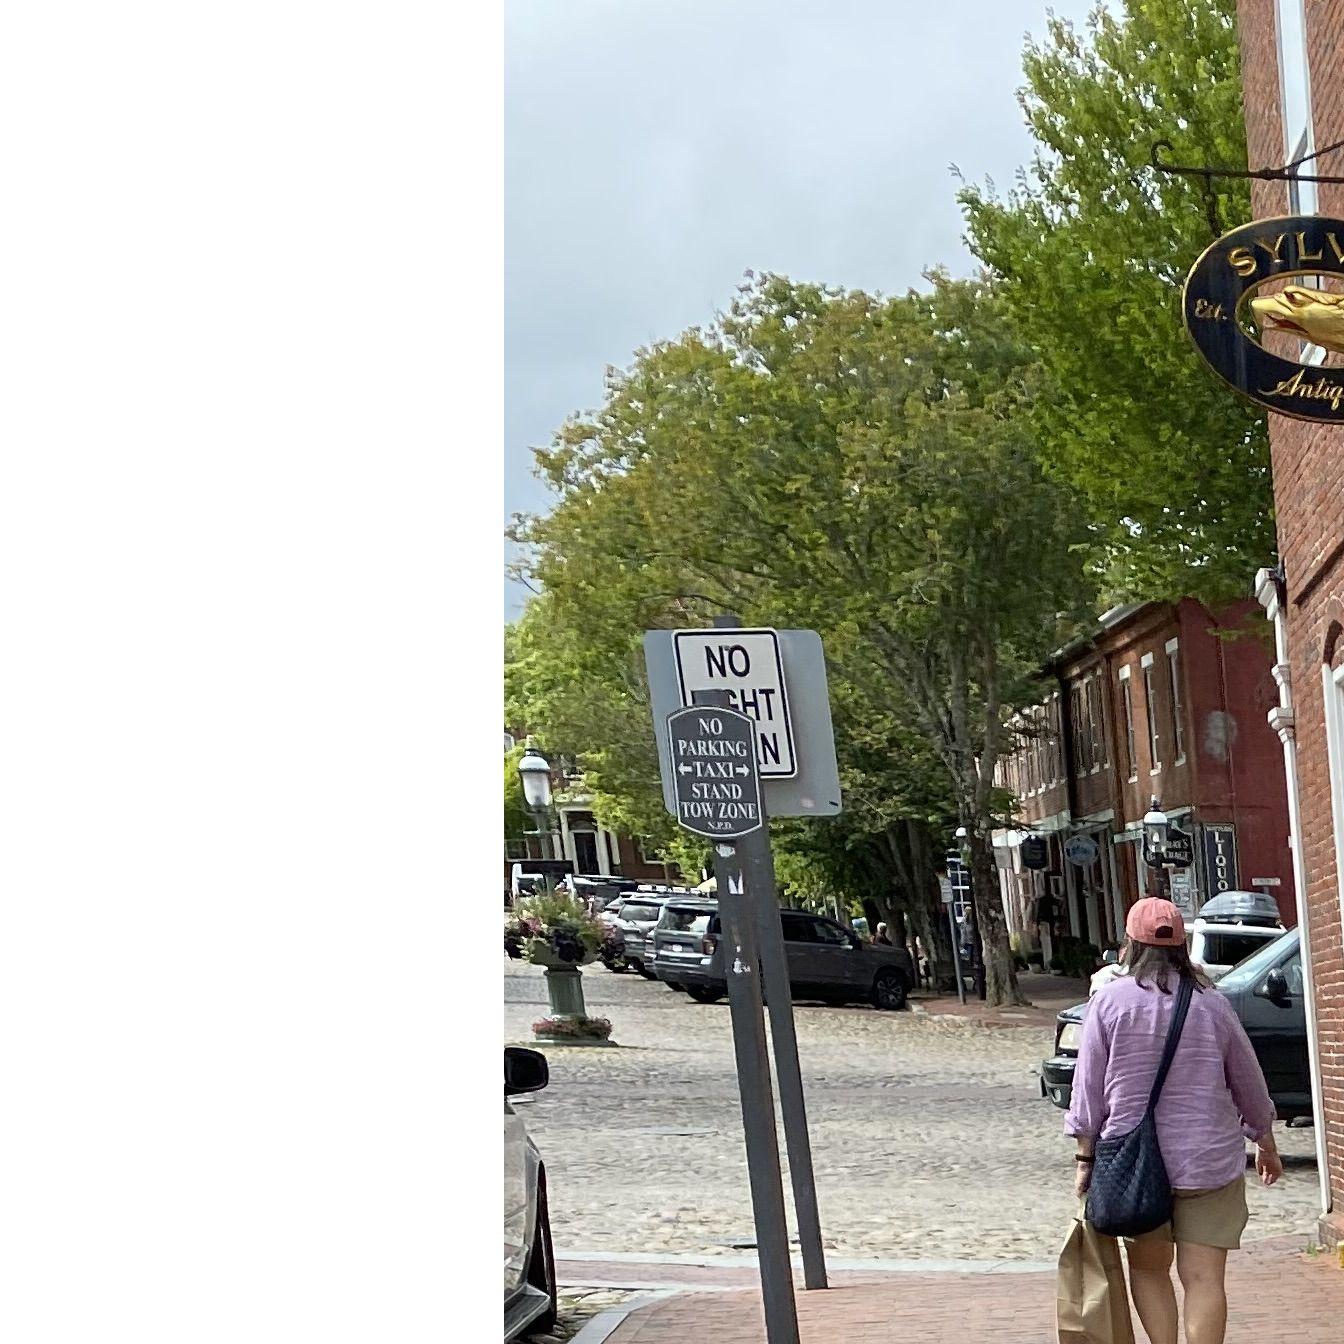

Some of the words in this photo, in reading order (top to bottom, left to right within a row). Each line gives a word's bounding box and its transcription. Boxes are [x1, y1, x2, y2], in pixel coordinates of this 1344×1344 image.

[704, 644, 750, 678] NO
[698, 718, 723, 735] NO
[678, 739, 747, 757] PARKING
[693, 761, 734, 778] TAXI
[692, 782, 742, 800] STAND
[681, 801, 714, 819] TOW
[718, 802, 757, 820] ZONE
